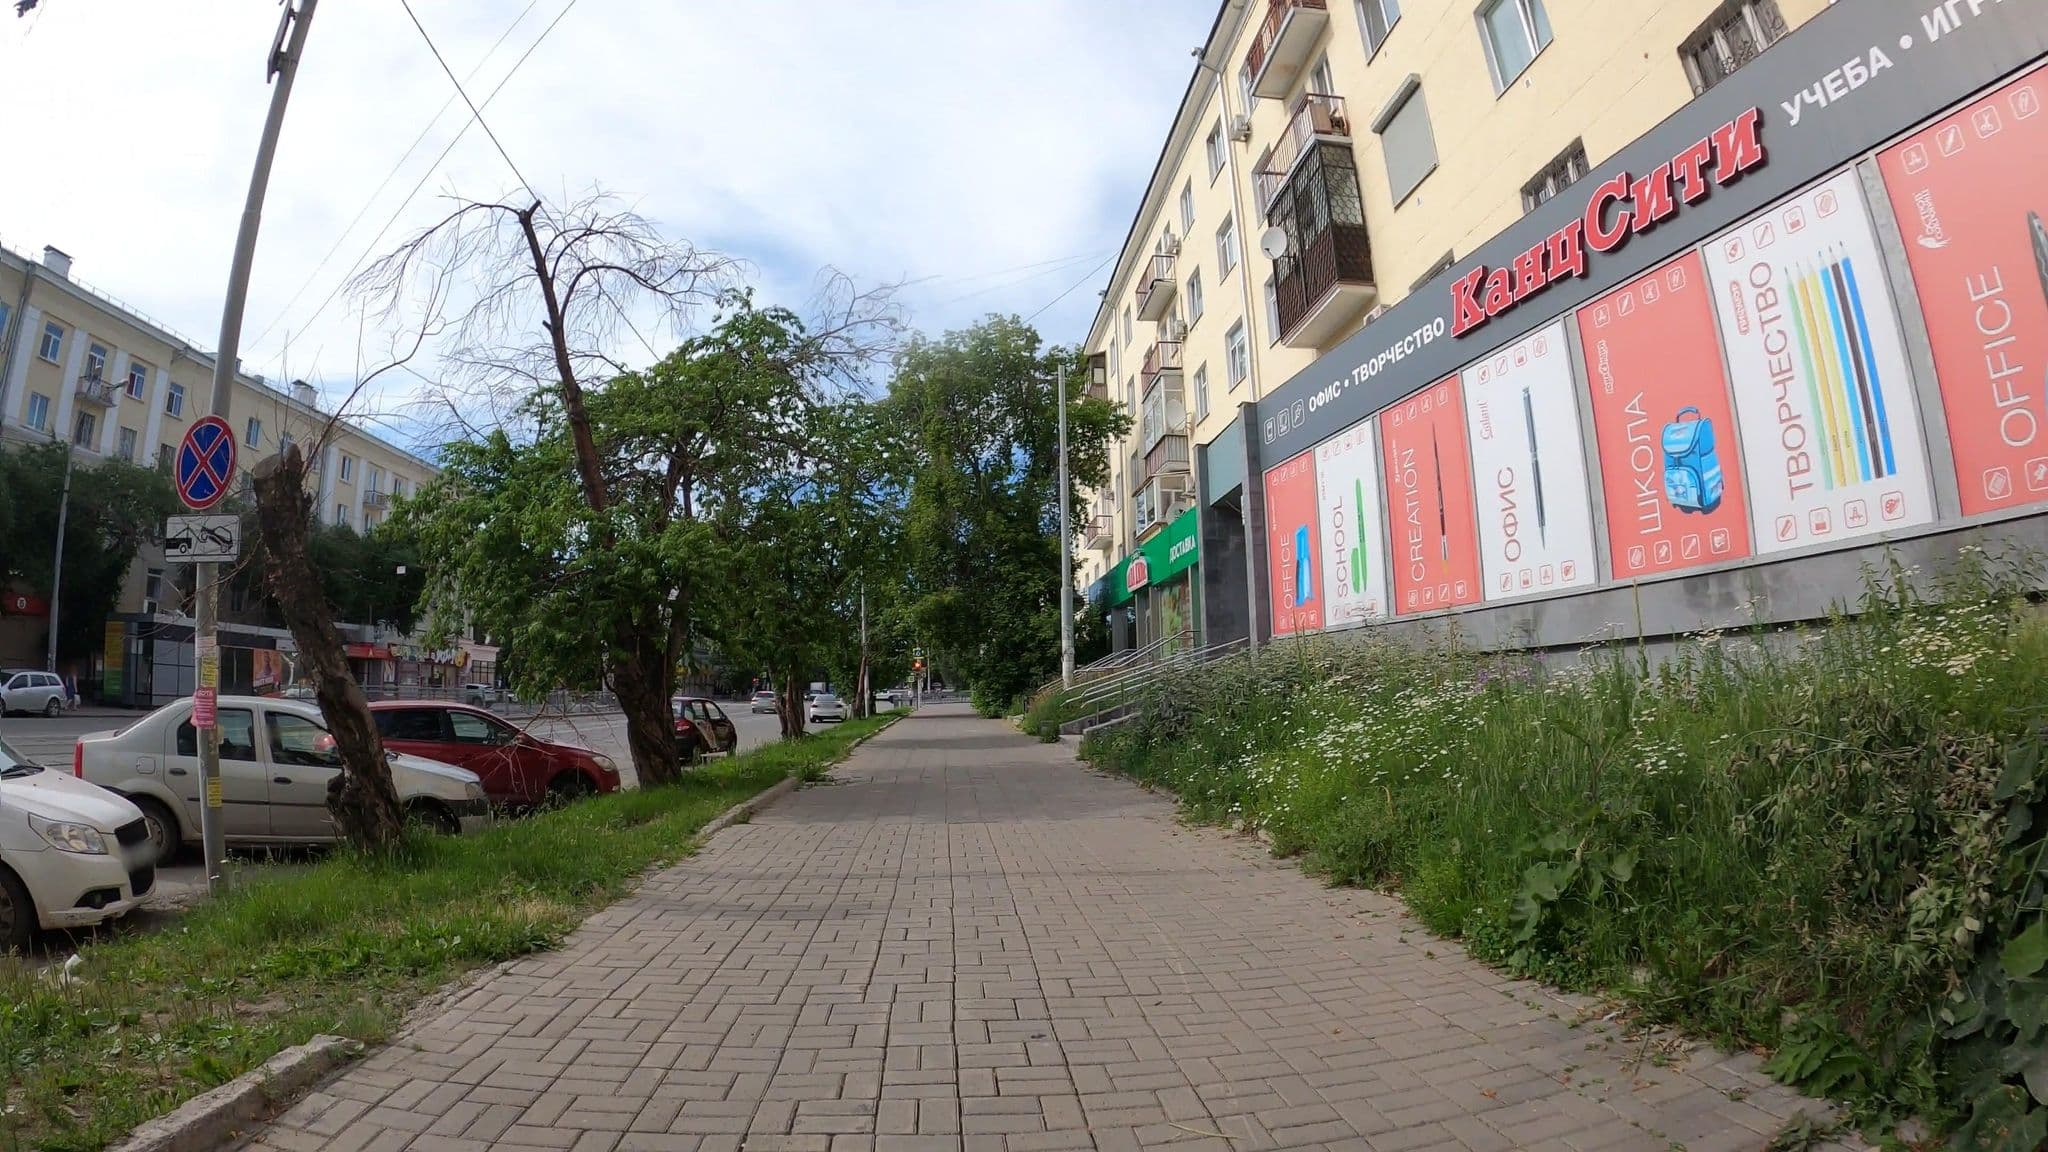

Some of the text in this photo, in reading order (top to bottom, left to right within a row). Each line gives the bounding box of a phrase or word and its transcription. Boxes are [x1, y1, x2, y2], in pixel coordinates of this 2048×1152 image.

[1780, 46, 1894, 126] УЧЕБА
[1450, 106, 1763, 337] КанцСити
[1308, 317, 1445, 412] ОФИС ТВОРЧЕСТВО
[1749, 261, 1814, 500] ТВОРЧЕСТВО
[1965, 265, 2037, 446] OFFICE
[1401, 448, 1425, 582] CREATION
[1497, 466, 1522, 563] ОФИС
[1624, 391, 1662, 535] ШКОЛА
[1280, 533, 1294, 610] OFFICE
[1333, 495, 1349, 598] SCHOOL
